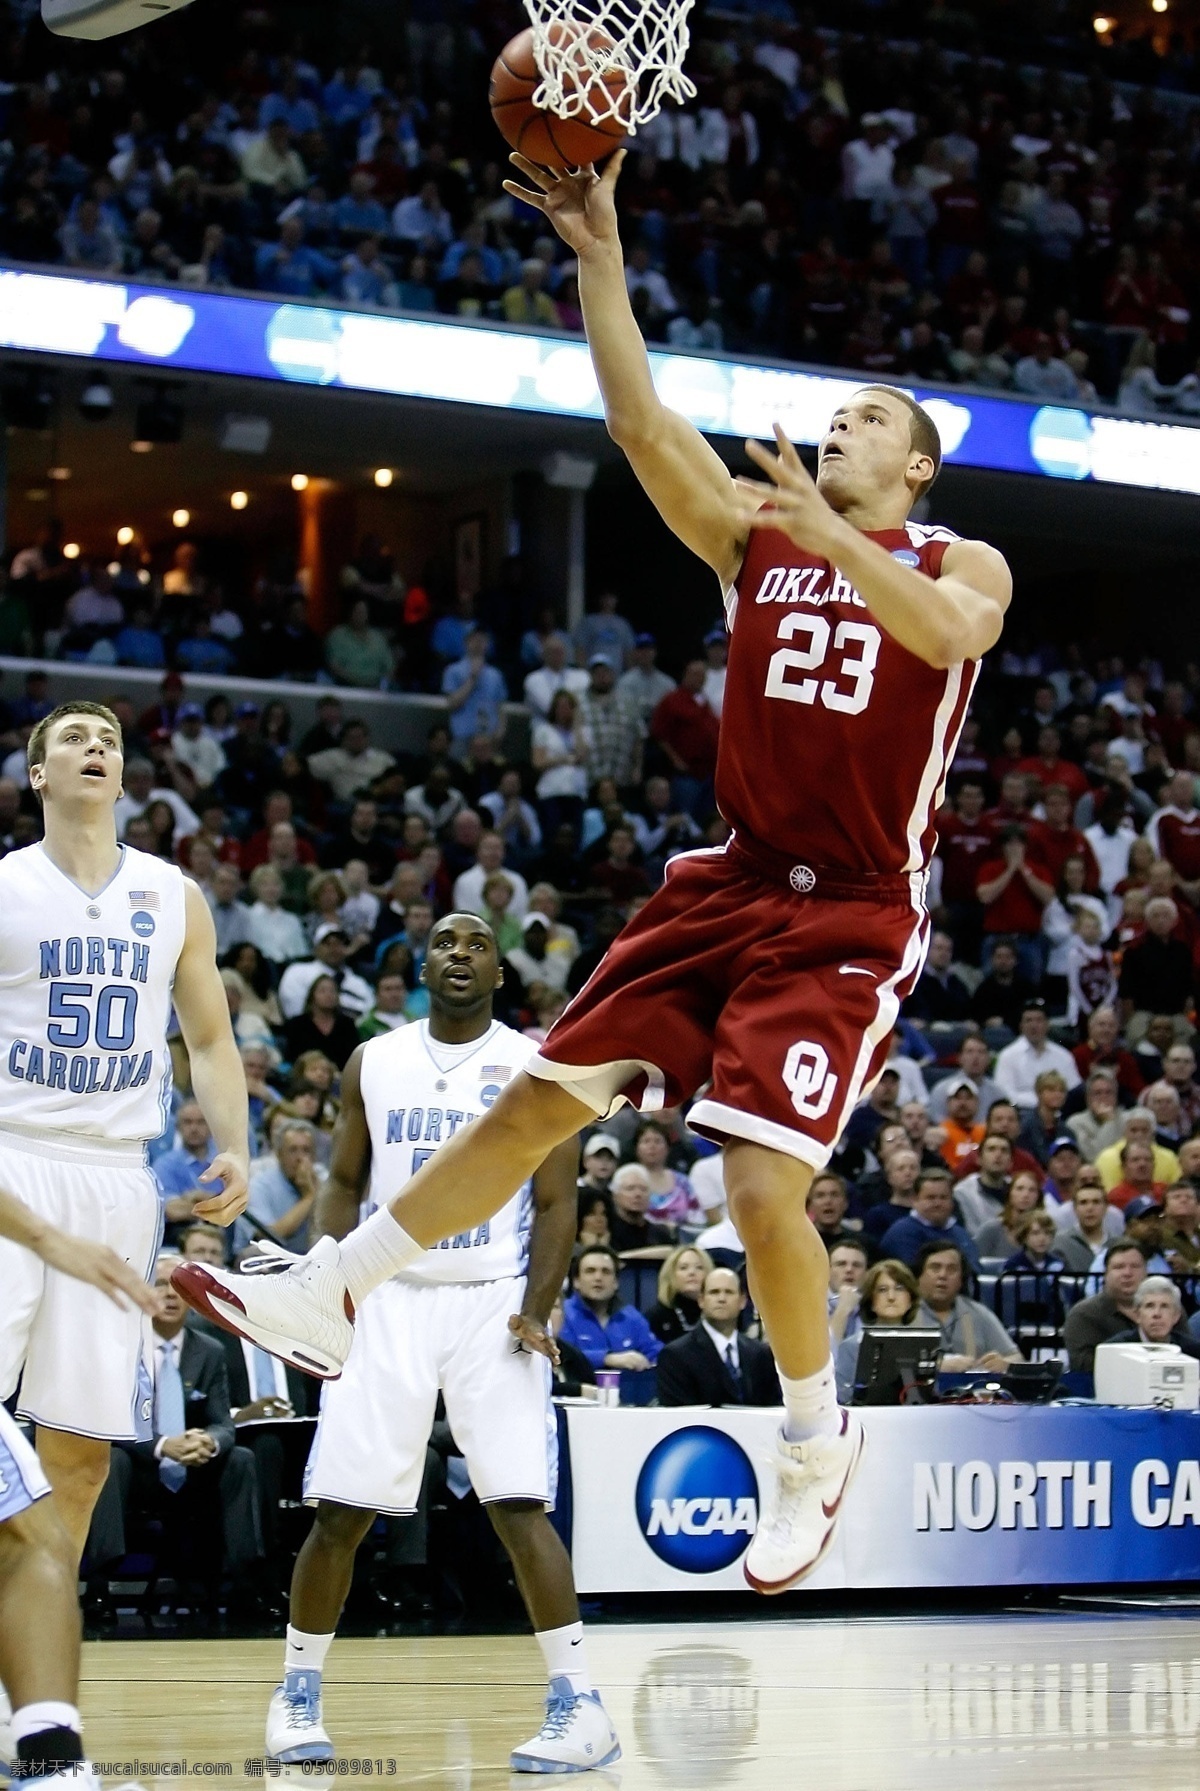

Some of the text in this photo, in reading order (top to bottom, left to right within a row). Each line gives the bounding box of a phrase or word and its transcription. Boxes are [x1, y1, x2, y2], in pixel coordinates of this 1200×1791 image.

[755, 567, 867, 608] OKLH
[764, 611, 882, 716] 23
[39, 936, 150, 983] NORTH
[47, 981, 138, 1051] 50
[8, 1039, 153, 1094] CAROLINA
[646, 1497, 758, 1536] NCAA
[913, 1458, 1200, 1531] NORTH CA
